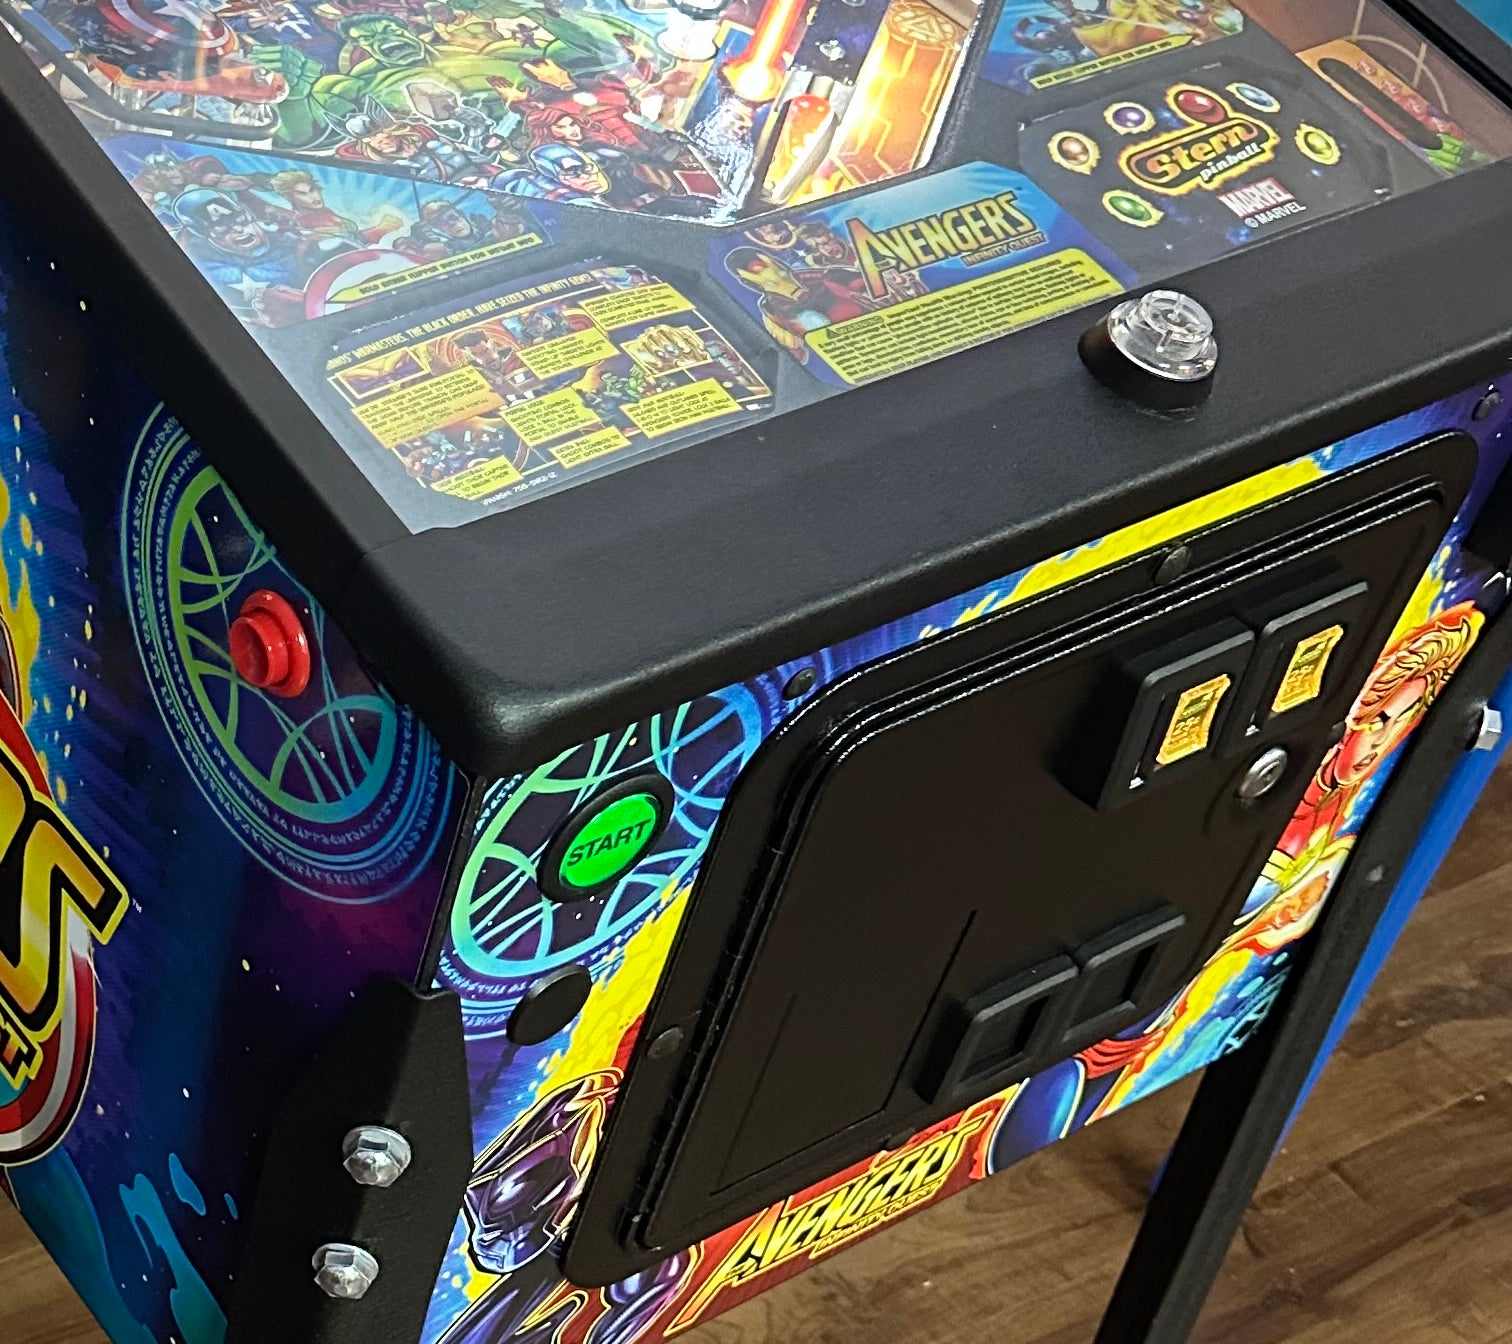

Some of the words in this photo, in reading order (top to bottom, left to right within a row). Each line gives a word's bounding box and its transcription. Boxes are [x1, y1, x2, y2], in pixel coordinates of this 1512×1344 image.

[1146, 125, 1249, 178] Stern
[1200, 142, 1262, 181] pinball
[1219, 179, 1294, 218] MARVEL
[1257, 201, 1307, 225] MARVEL
[845, 190, 1037, 300] AVENGERS
[567, 818, 652, 867] START
[669, 1111, 993, 1336] AVENGERS
